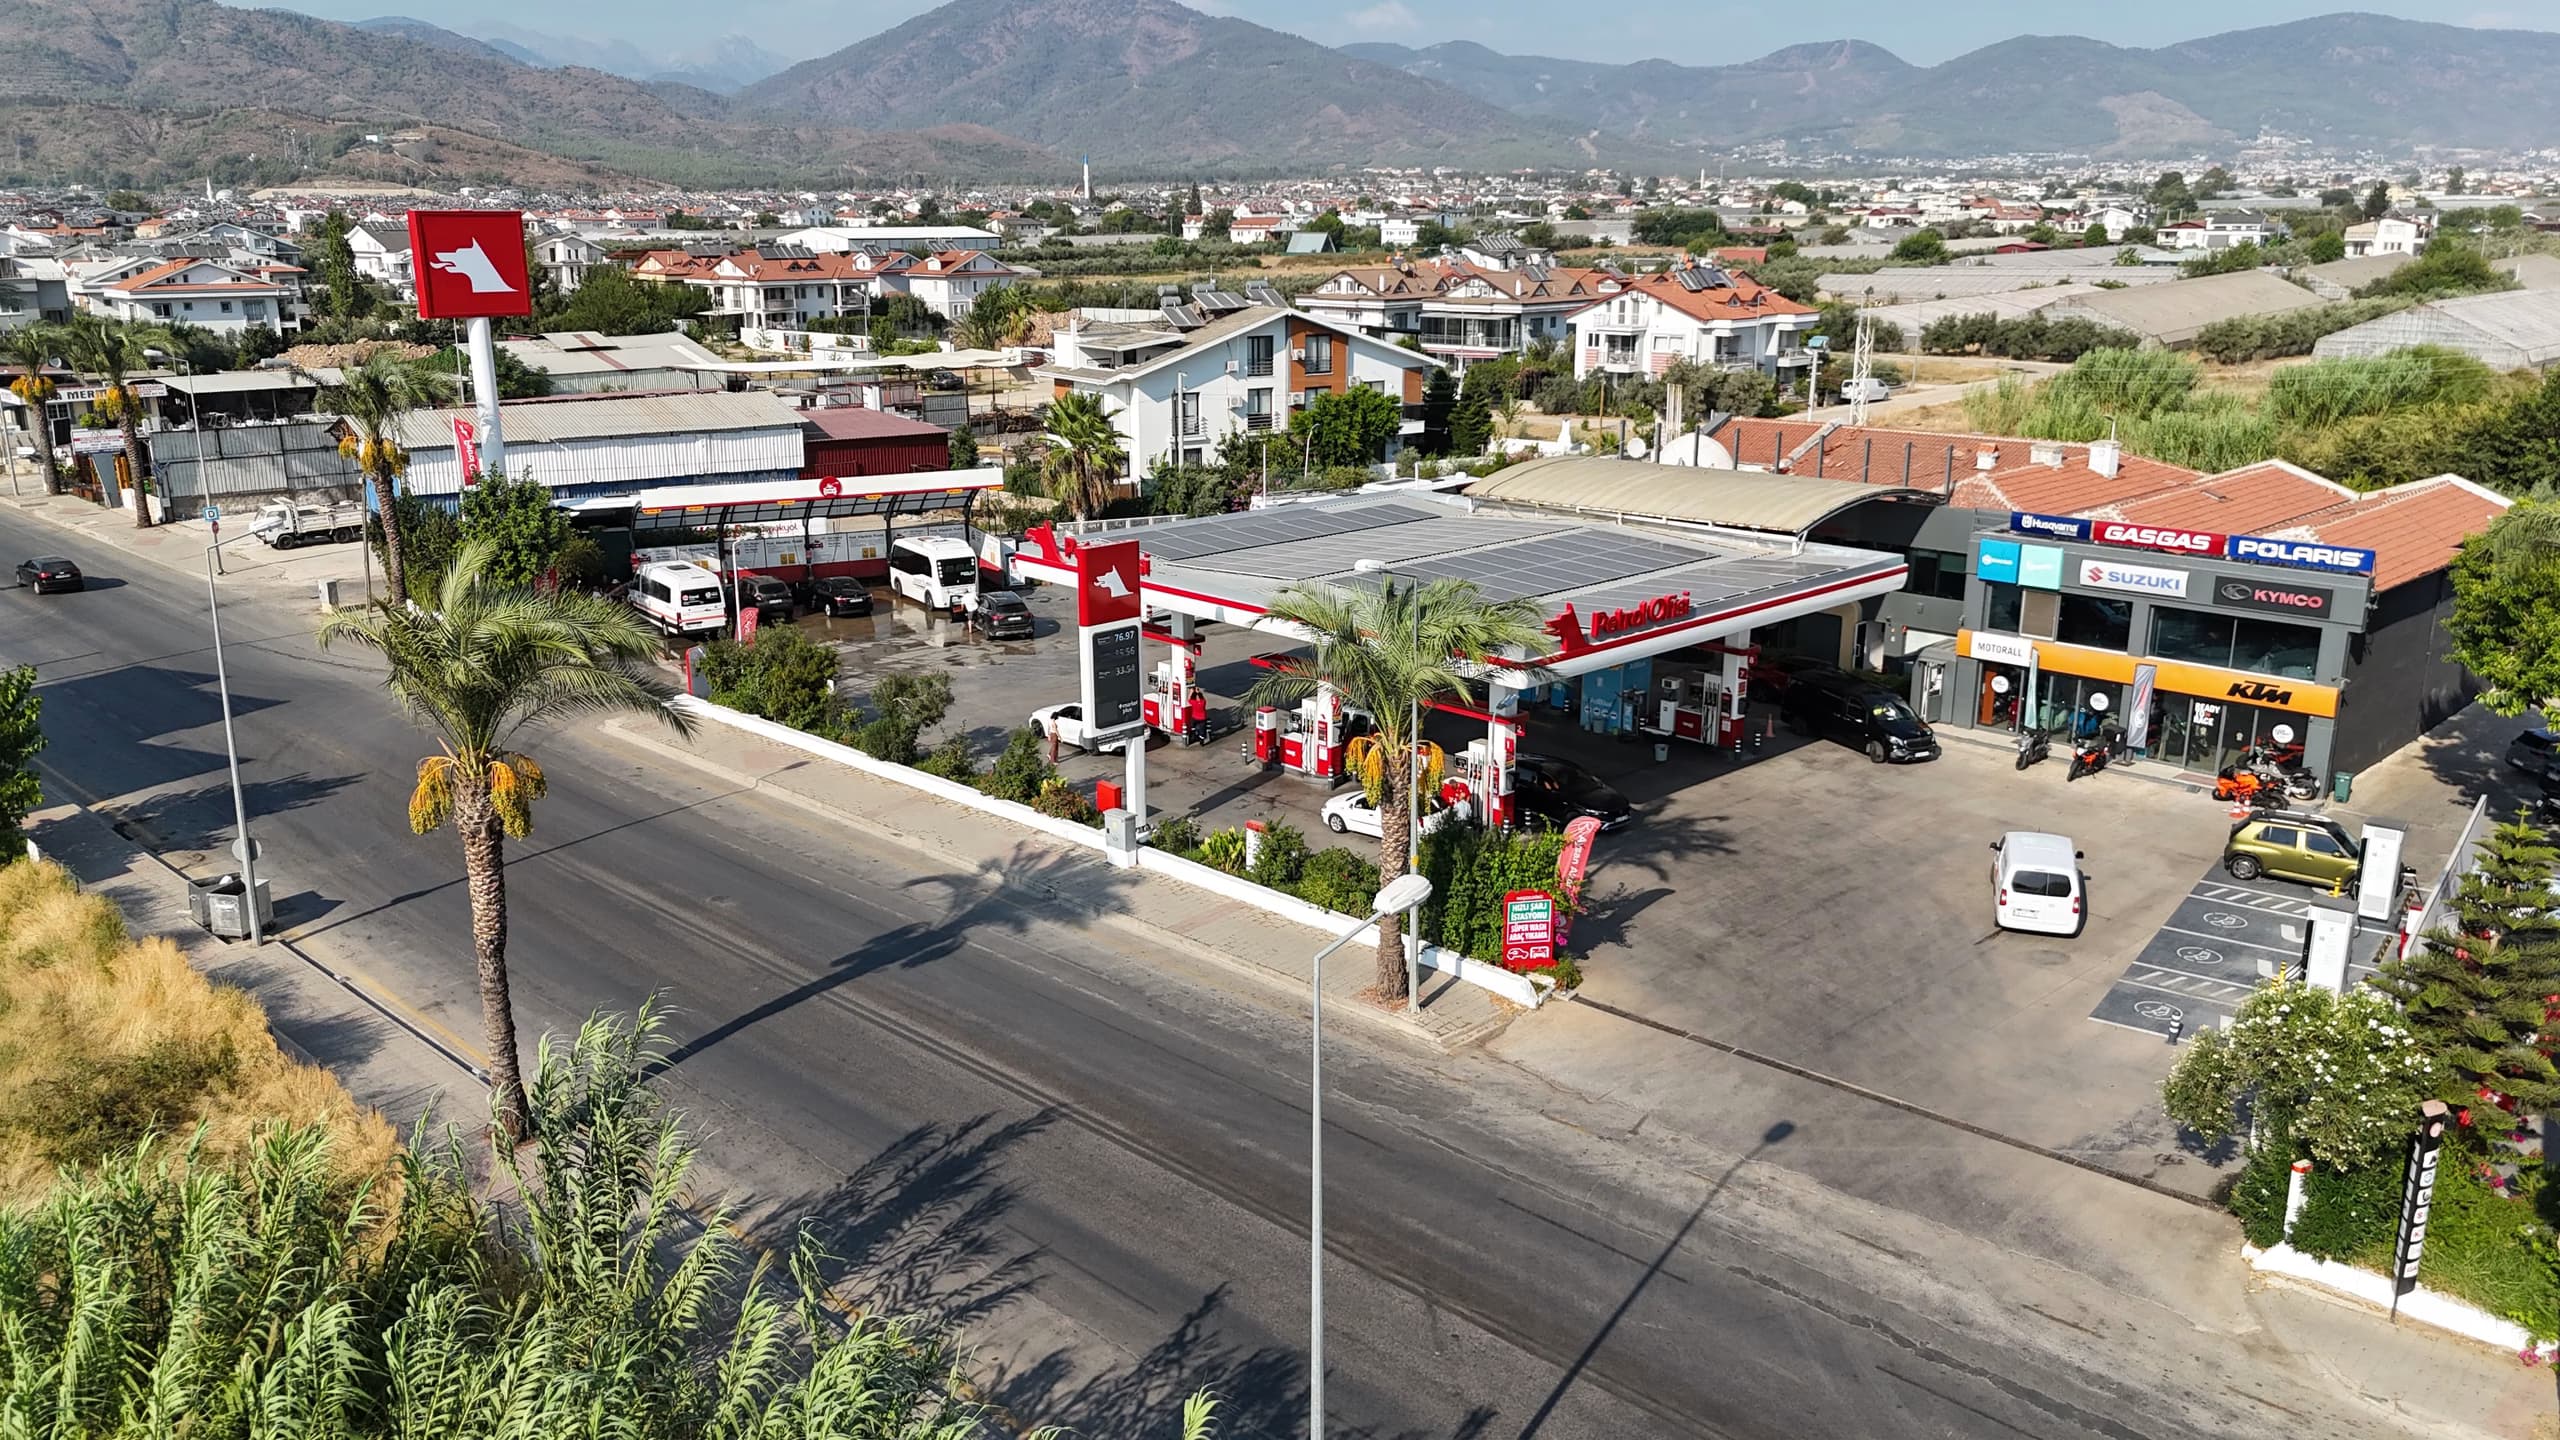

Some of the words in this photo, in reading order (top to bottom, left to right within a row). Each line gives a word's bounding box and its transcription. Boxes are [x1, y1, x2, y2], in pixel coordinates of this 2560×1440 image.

[2032, 519, 2078, 533] Husqvarna
[2104, 525, 2212, 550] GASGAS
[2238, 540, 2364, 568] POLARIS
[2108, 571, 2180, 591] SUZUKI
[2254, 589, 2323, 608] KYMCO
[1591, 600, 1648, 638] Petrol
[1977, 642, 2023, 657] MOTORALL
[2226, 681, 2293, 705] KTM
[2194, 702, 2221, 714] READY
[1512, 903, 1529, 912] HIZLI
[1531, 902, 1547, 912] ŞARJ
[1511, 911, 1548, 921] İSTASYONU
[1511, 923, 1529, 932] SÜPER
[1530, 923, 1547, 931] WASH
[1509, 933, 1524, 942] ARAÇ
